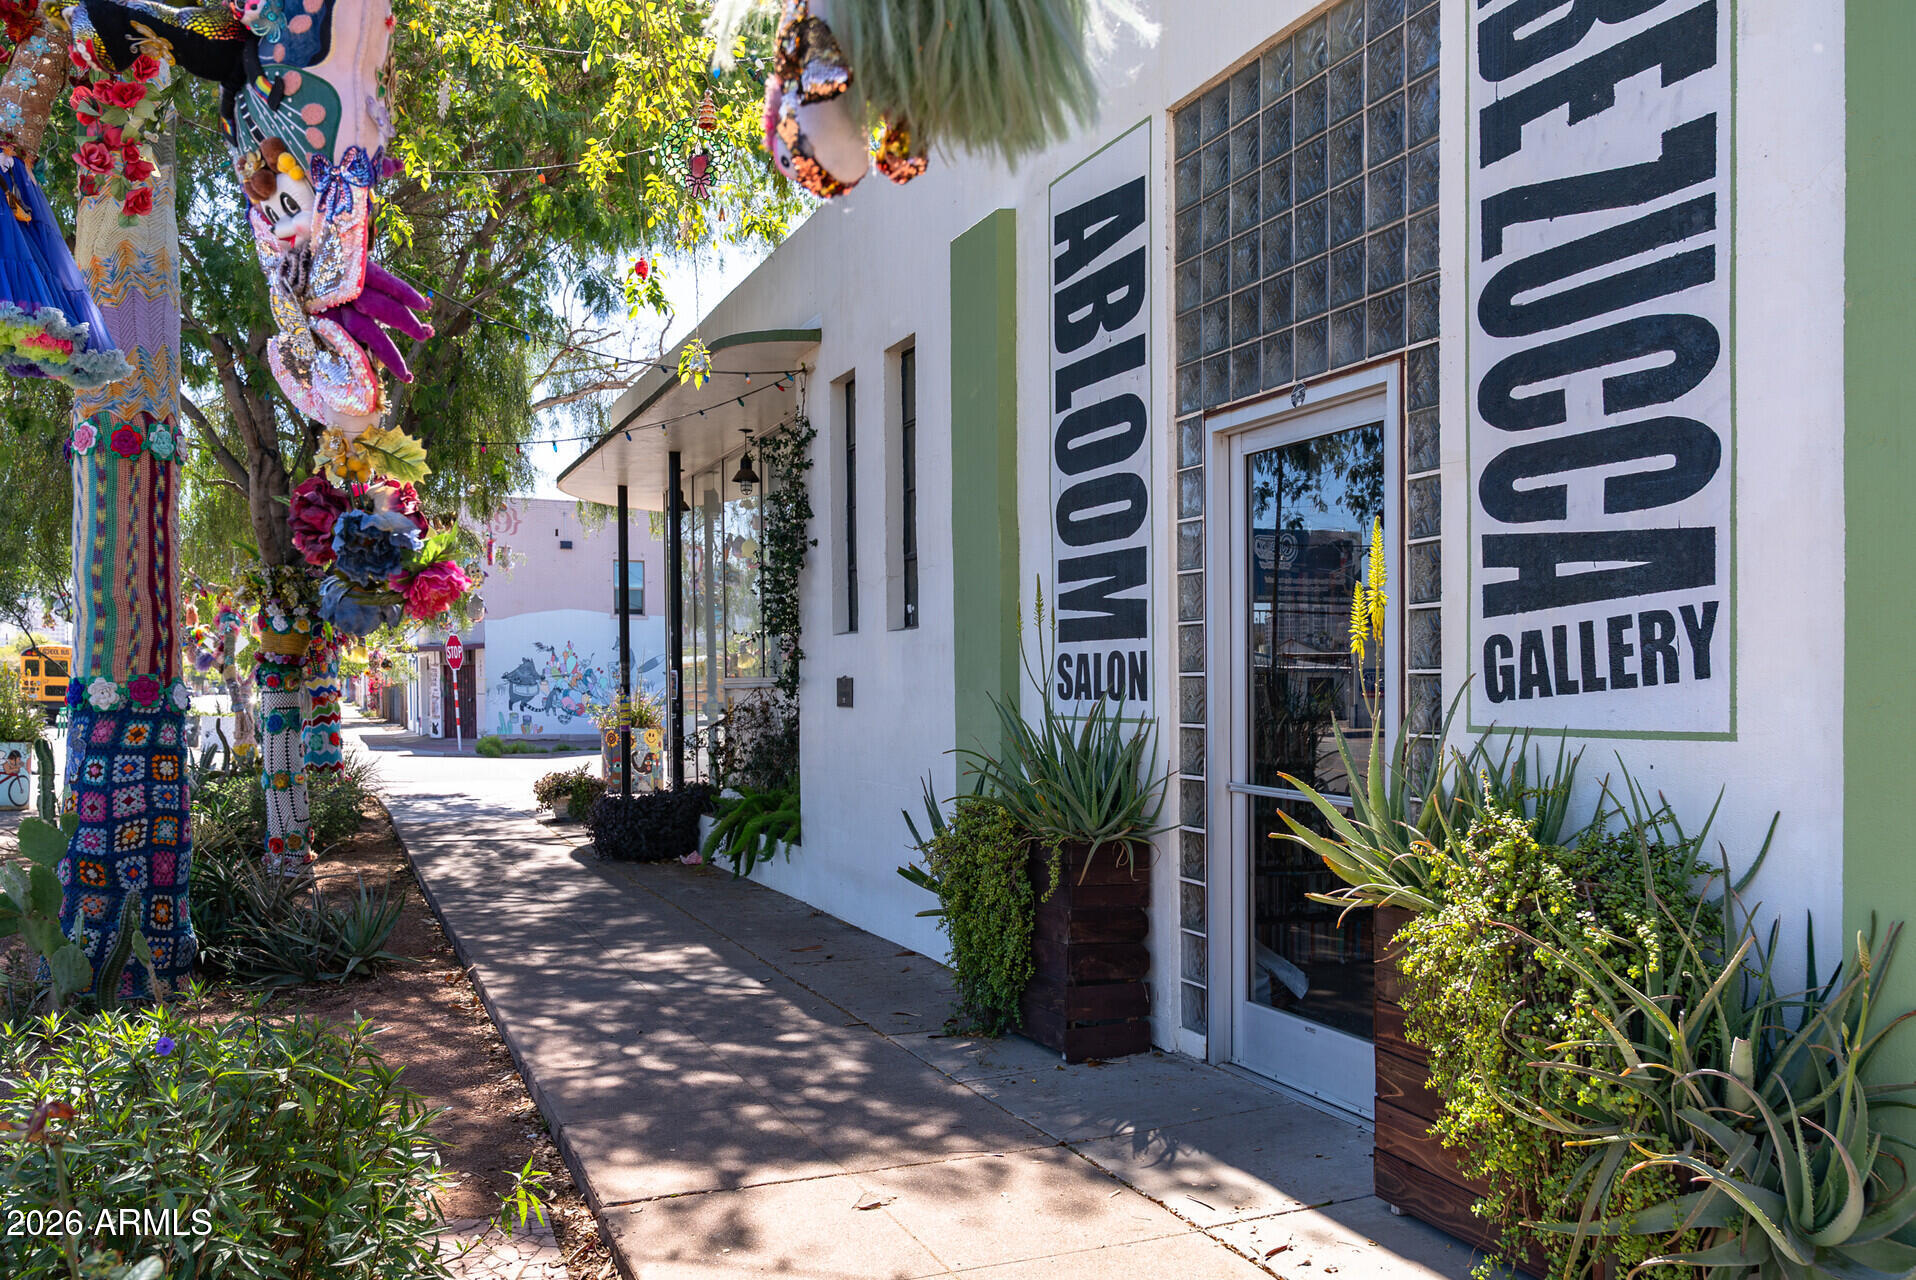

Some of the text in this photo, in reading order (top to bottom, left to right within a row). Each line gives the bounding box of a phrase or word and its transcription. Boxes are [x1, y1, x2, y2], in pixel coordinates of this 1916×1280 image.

[1478, 0, 1721, 618] BE ZUCCA
[1054, 176, 1147, 643] ABLOOM
[447, 645, 462, 659] STOP
[1057, 650, 1147, 701] SALON
[1483, 601, 1719, 703] GALLERY
